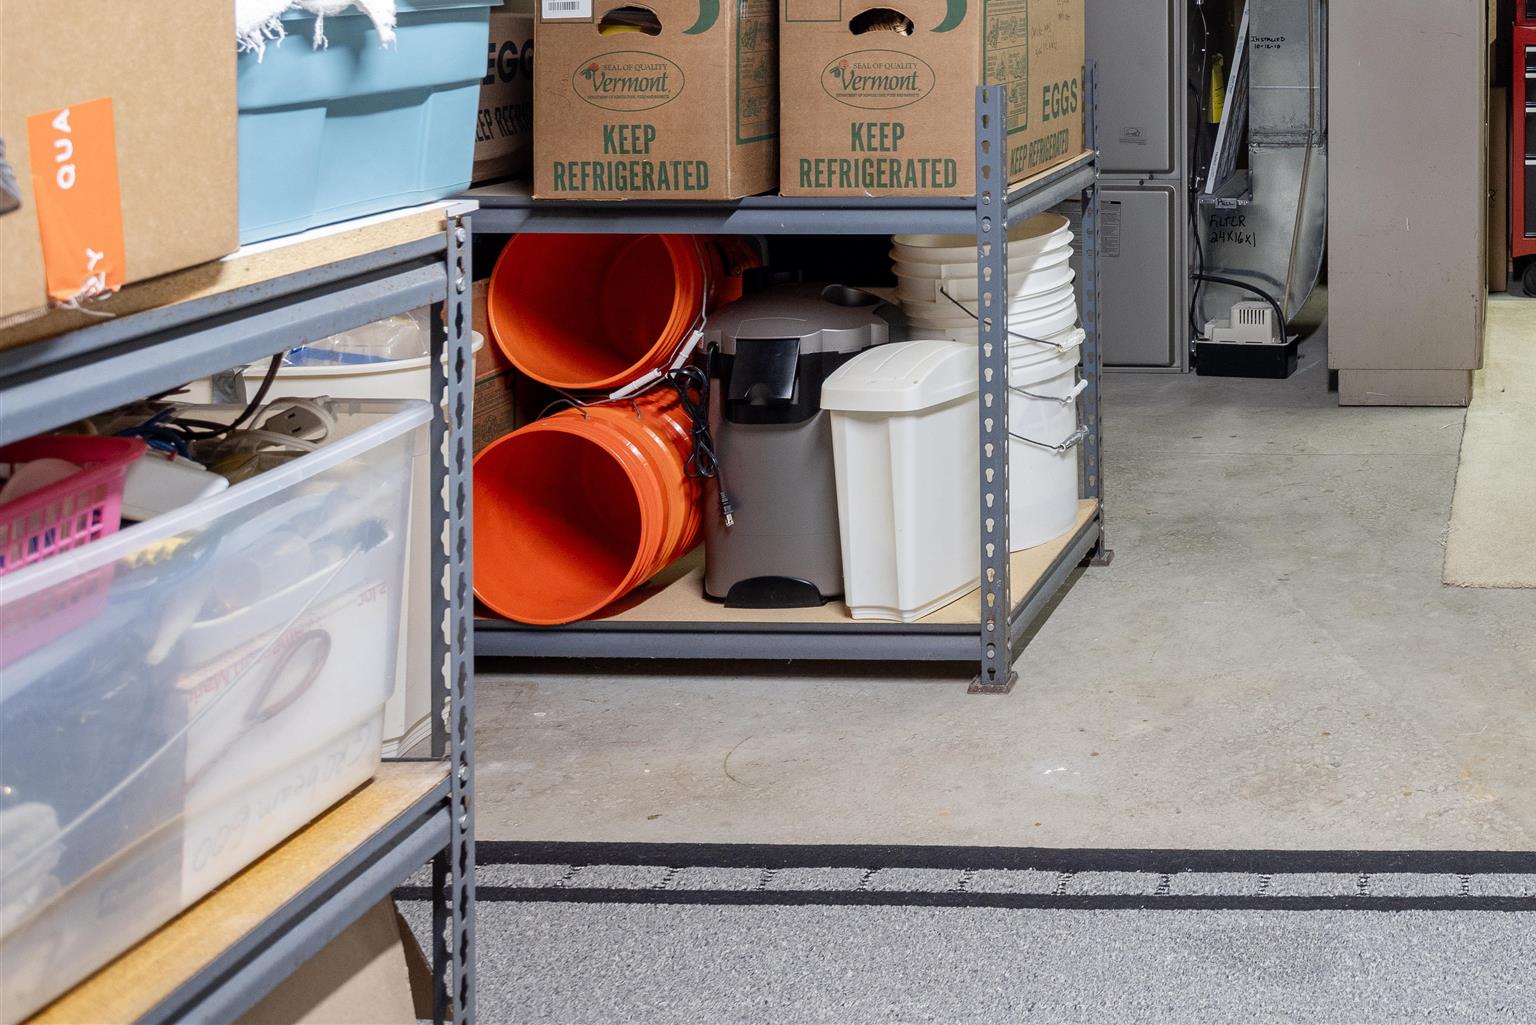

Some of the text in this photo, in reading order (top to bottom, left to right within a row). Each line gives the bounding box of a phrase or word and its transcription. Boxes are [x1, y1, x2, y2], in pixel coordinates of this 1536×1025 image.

[592, 71, 669, 93] Vermont
[634, 63, 668, 71] QUALITY
[842, 70, 919, 91] Vermont
[884, 62, 918, 71] QUALITY
[1042, 78, 1078, 122] EGGS
[475, 107, 497, 143] EEP
[603, 124, 657, 155] KEEP
[851, 122, 905, 152] KEEP
[51, 108, 77, 190] QUA
[1009, 128, 1069, 176] KEEP REFRIGERATED
[553, 160, 709, 192] REFRIGERATED
[799, 158, 957, 189] REFRIGERATED
[1210, 214, 1246, 227] FILTER
